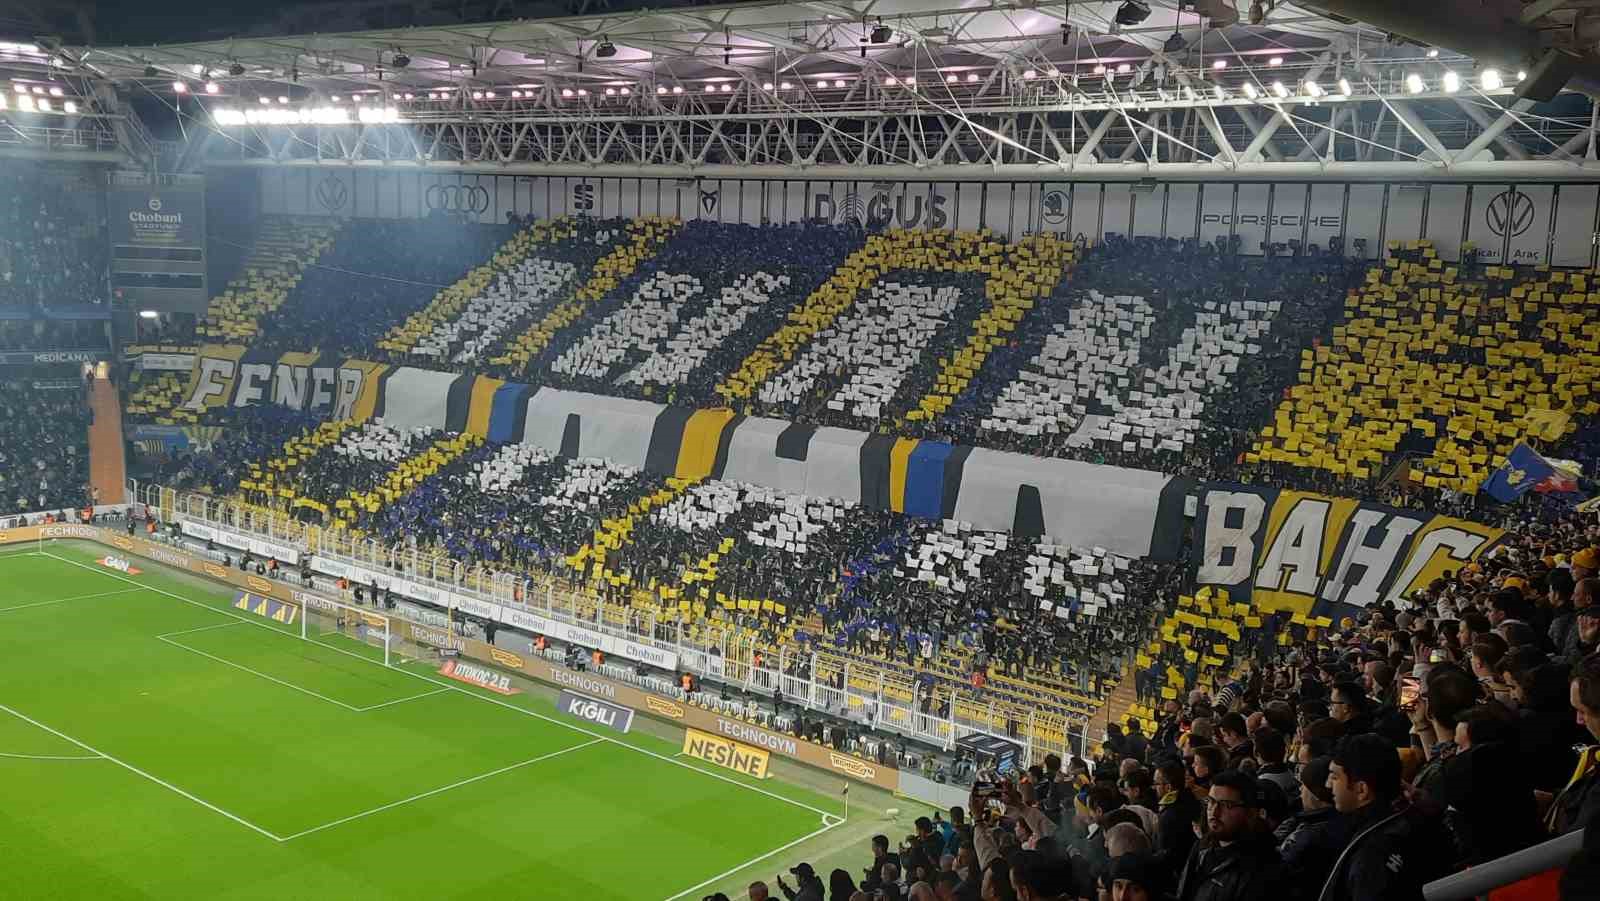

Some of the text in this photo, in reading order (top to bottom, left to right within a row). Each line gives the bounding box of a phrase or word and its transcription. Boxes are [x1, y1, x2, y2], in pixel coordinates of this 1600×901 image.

[129, 211, 182, 224] Chobani
[1202, 214, 1340, 227] PORSCHE
[183, 357, 364, 423] FENER
[625, 644, 665, 663] Chobani
[550, 668, 616, 698] TECHNOGYM
[717, 718, 797, 754] TECHNOGYM
